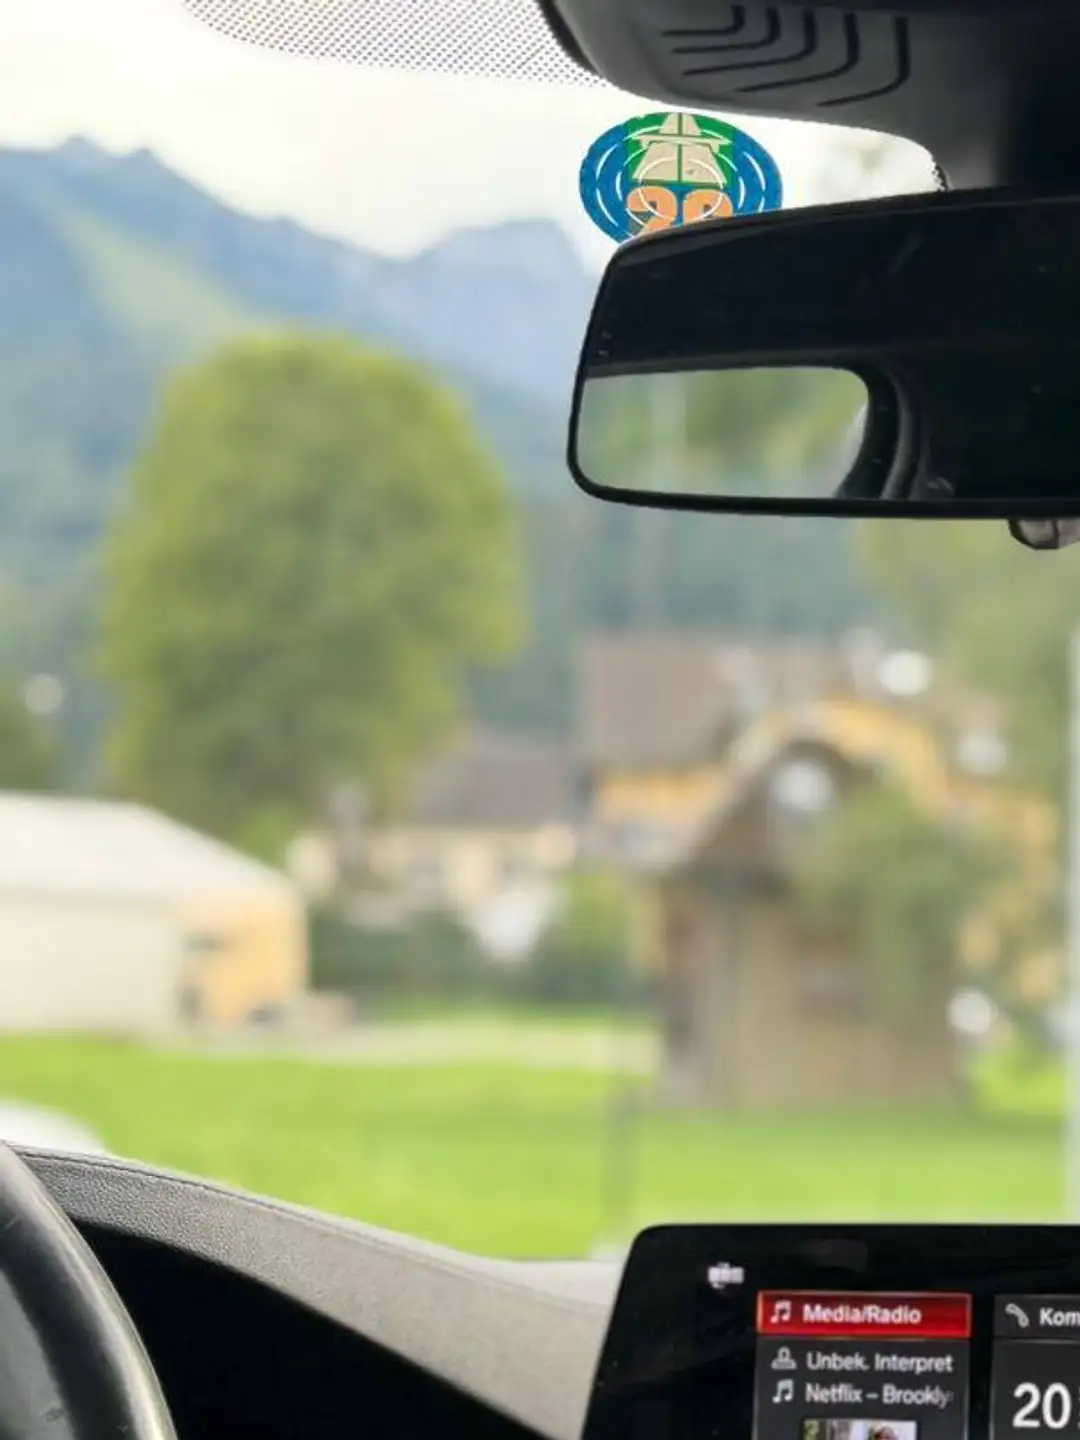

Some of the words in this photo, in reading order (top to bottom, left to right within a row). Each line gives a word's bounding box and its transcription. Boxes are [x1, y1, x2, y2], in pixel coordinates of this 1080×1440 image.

[802, 1303, 922, 1324] Media/Radio
[806, 1352, 869, 1370] Unbek.
[874, 1353, 954, 1375] Interpret
[805, 1382, 863, 1402] Netflix
[1012, 1382, 1072, 1429] 20
